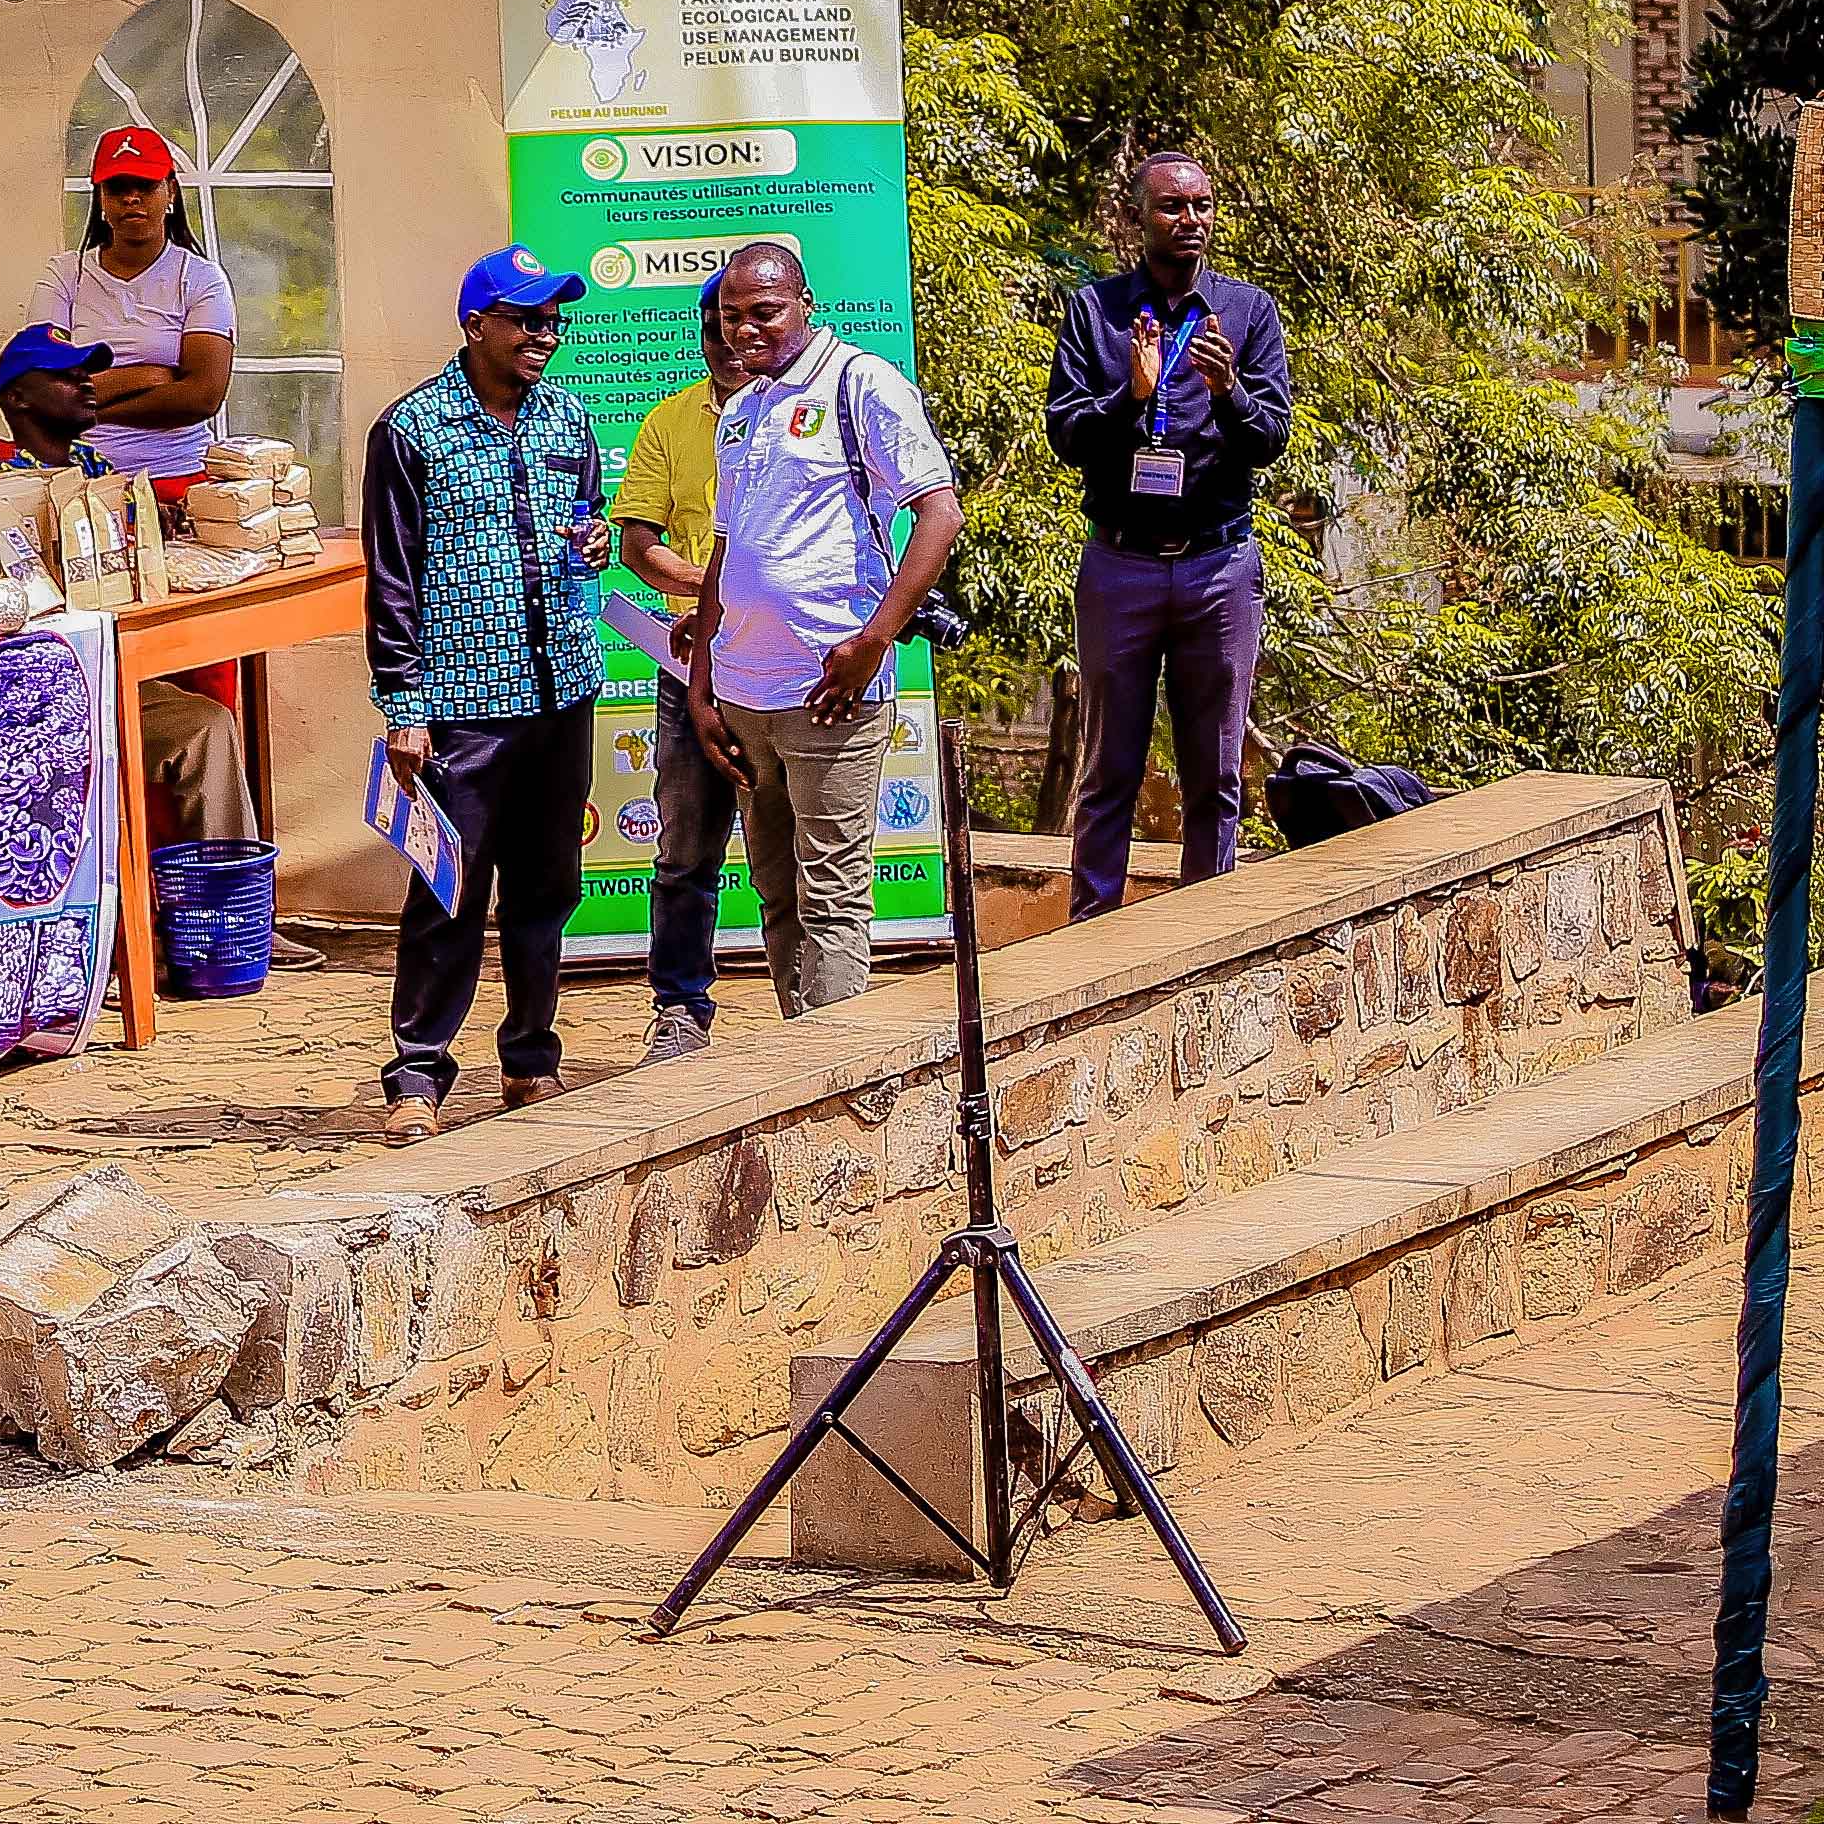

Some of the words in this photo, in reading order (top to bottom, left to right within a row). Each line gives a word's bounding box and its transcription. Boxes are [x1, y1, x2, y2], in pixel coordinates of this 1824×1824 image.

[681, 9, 801, 26] ECOLOGICAL
[803, 7, 852, 22] LAND
[682, 29, 720, 45] USE
[723, 27, 857, 44] MANAGEMENT/
[683, 50, 746, 65] PELUM
[748, 49, 775, 63] AU
[779, 47, 861, 63] BURUNDI
[550, 108, 592, 120] PELUM
[593, 107, 611, 118] AU
[613, 106, 668, 118] BURUNDI
[641, 141, 762, 169] VISION:
[561, 184, 689, 206] Communautés
[692, 183, 760, 200] utilisant
[766, 179, 875, 195] durablement
[606, 204, 649, 223] leurs
[653, 203, 745, 222] ressources
[748, 200, 835, 217] naturelles
[835, 299, 875, 313] dans
[878, 299, 893, 312] la
[843, 318, 904, 336] gestion
[637, 331, 677, 347] pour
[681, 328, 696, 341] la
[574, 350, 670, 366] écologique
